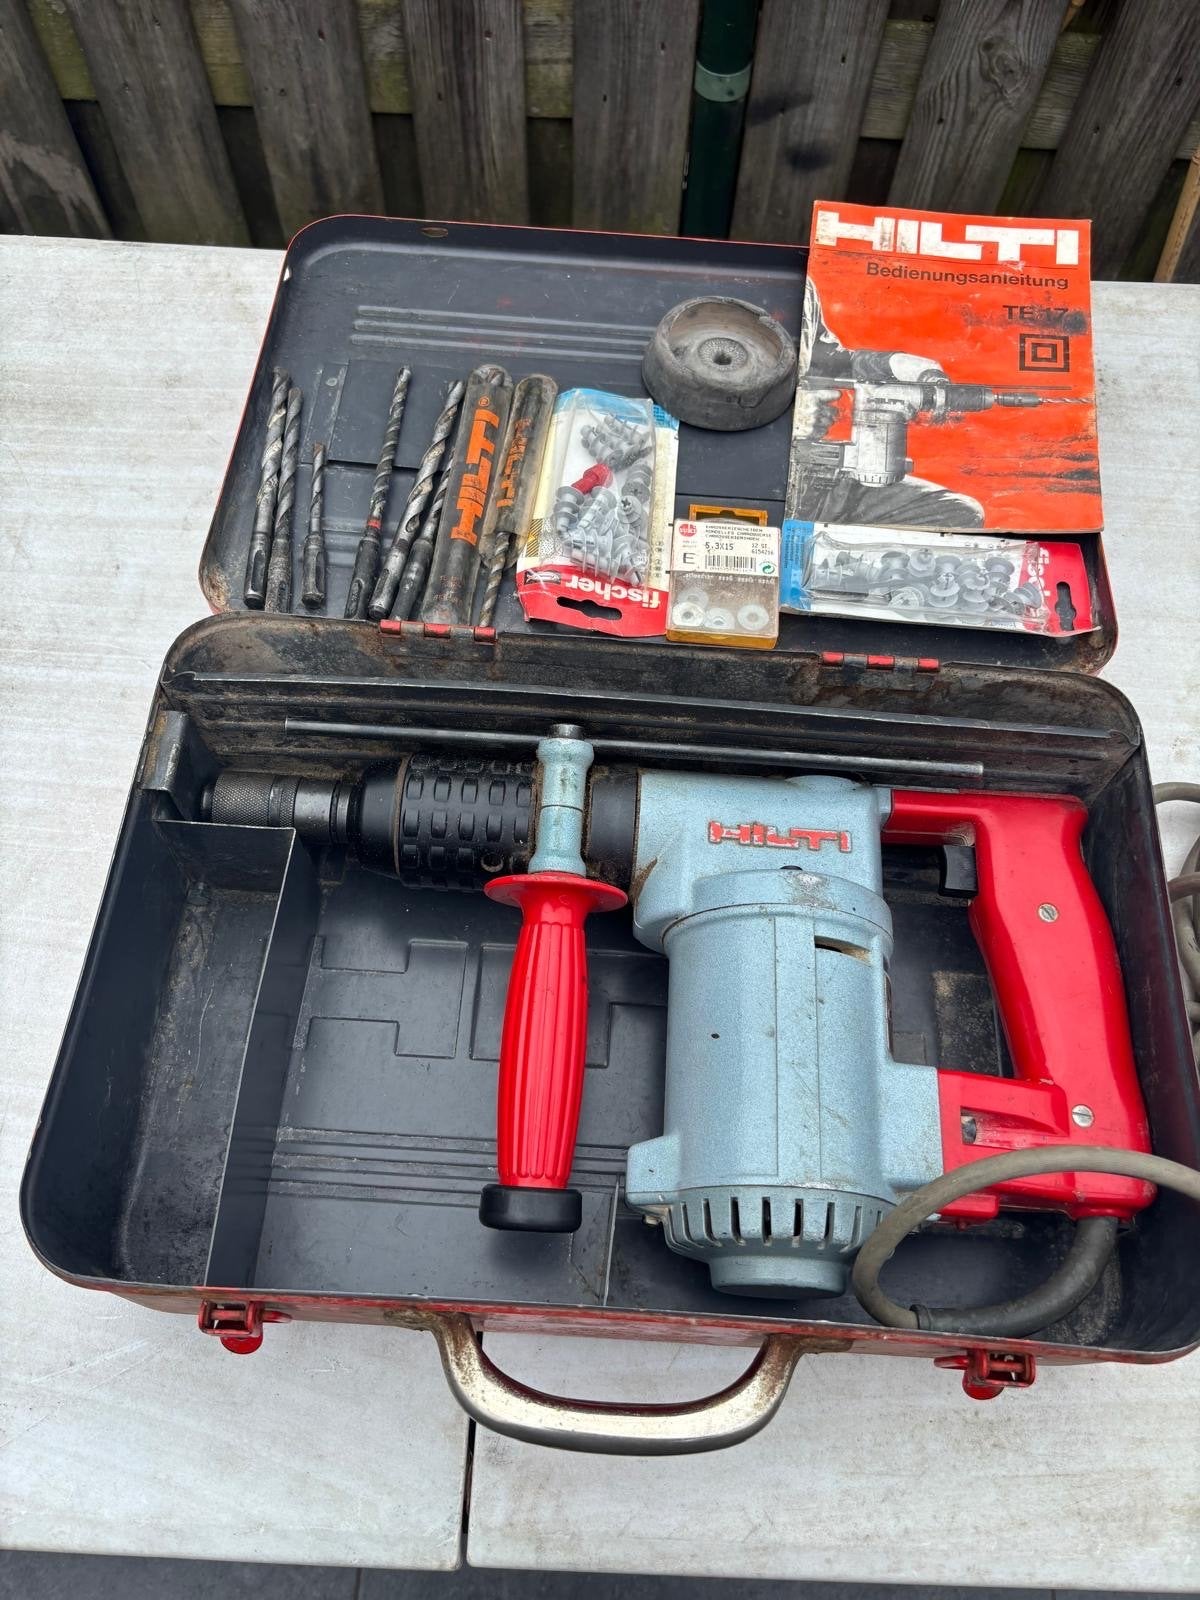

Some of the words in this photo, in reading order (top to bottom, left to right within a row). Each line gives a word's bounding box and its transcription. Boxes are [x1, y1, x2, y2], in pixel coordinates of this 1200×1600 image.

[816, 211, 1079, 265] HILTI
[866, 262, 1069, 289] Bedienungsanleitung
[1002, 305, 1034, 320] TE
[451, 408, 499, 546] HILTI
[683, 552, 696, 564] E
[565, 575, 661, 609] fischer
[708, 820, 853, 854] HILTI
